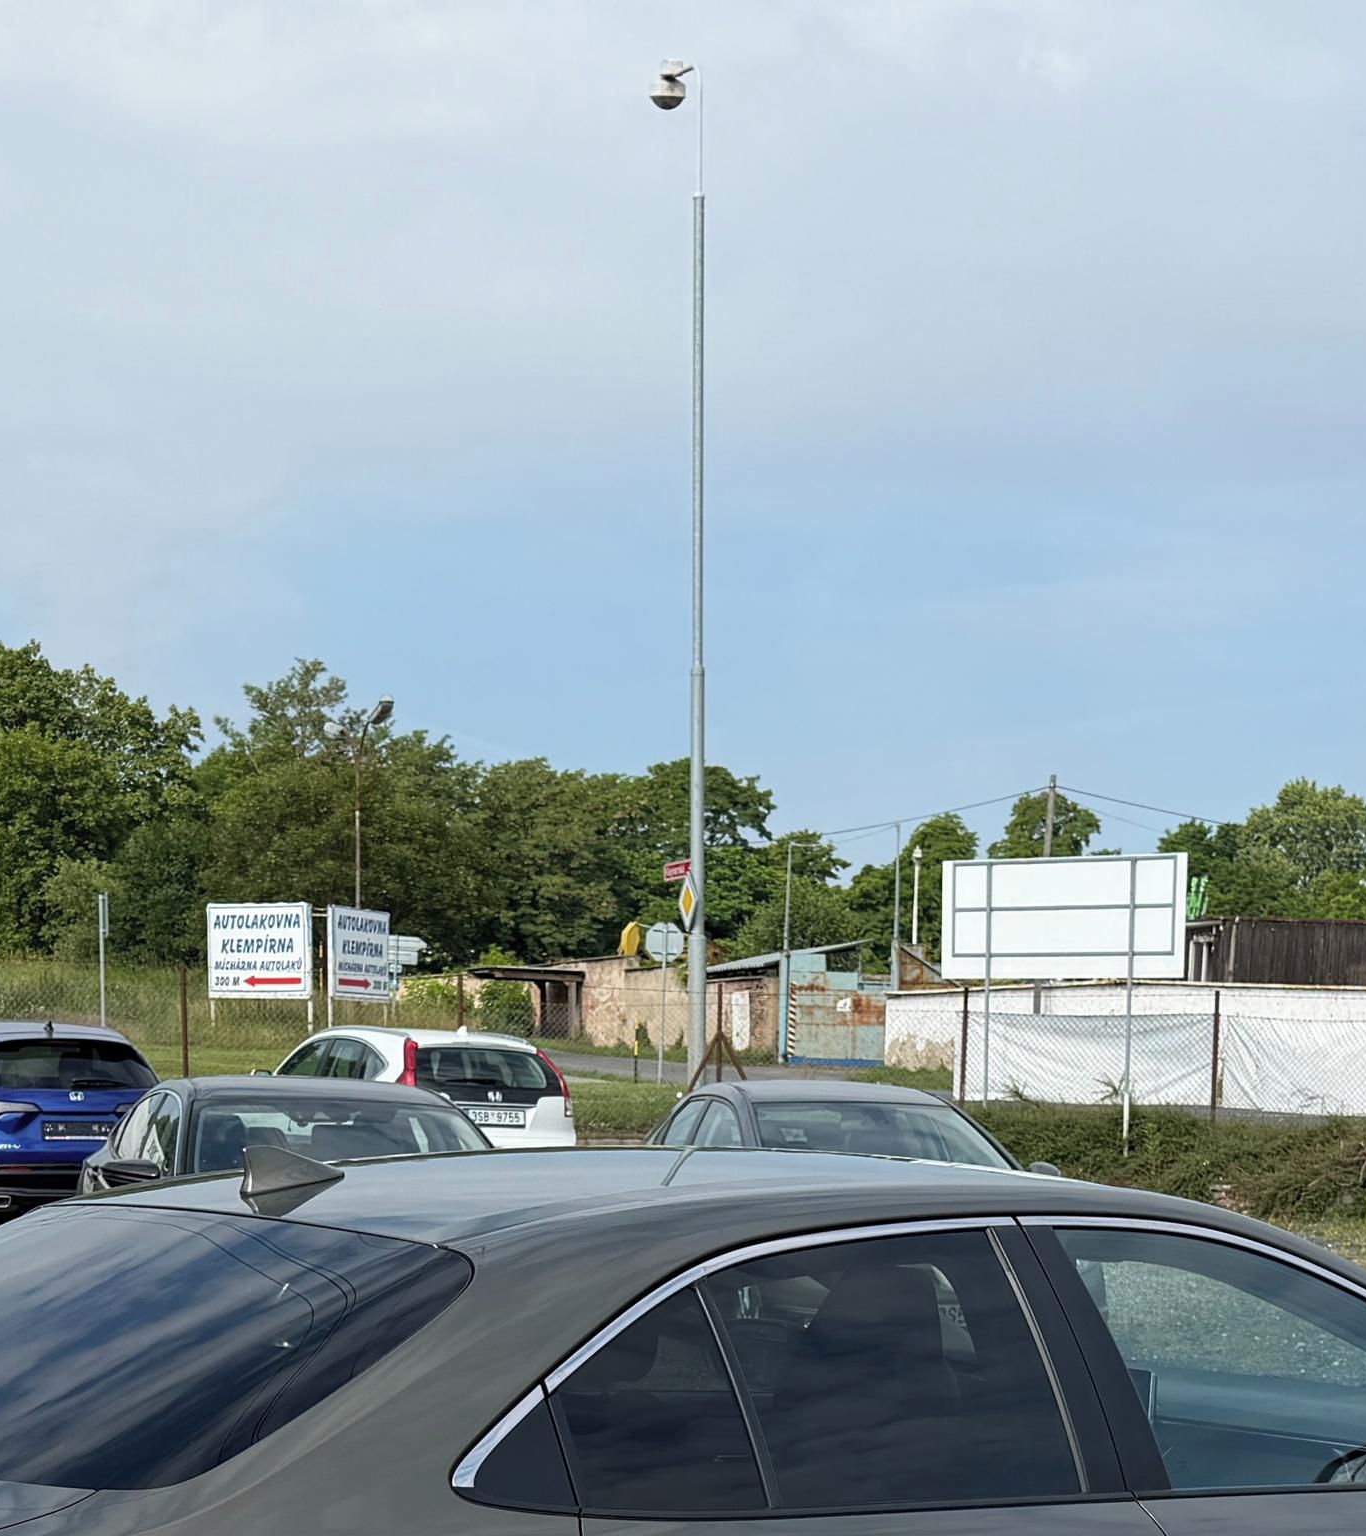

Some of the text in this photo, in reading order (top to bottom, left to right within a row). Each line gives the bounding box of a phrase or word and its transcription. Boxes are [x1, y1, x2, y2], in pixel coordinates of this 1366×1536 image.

[214, 913, 301, 930] AUTOLAKOVNA
[337, 914, 387, 935] AUTOLAKOVNA
[221, 934, 294, 954] KLEMPÍRNA
[214, 976, 240, 987] 300 M
[496, 1112, 521, 1123] 9755
